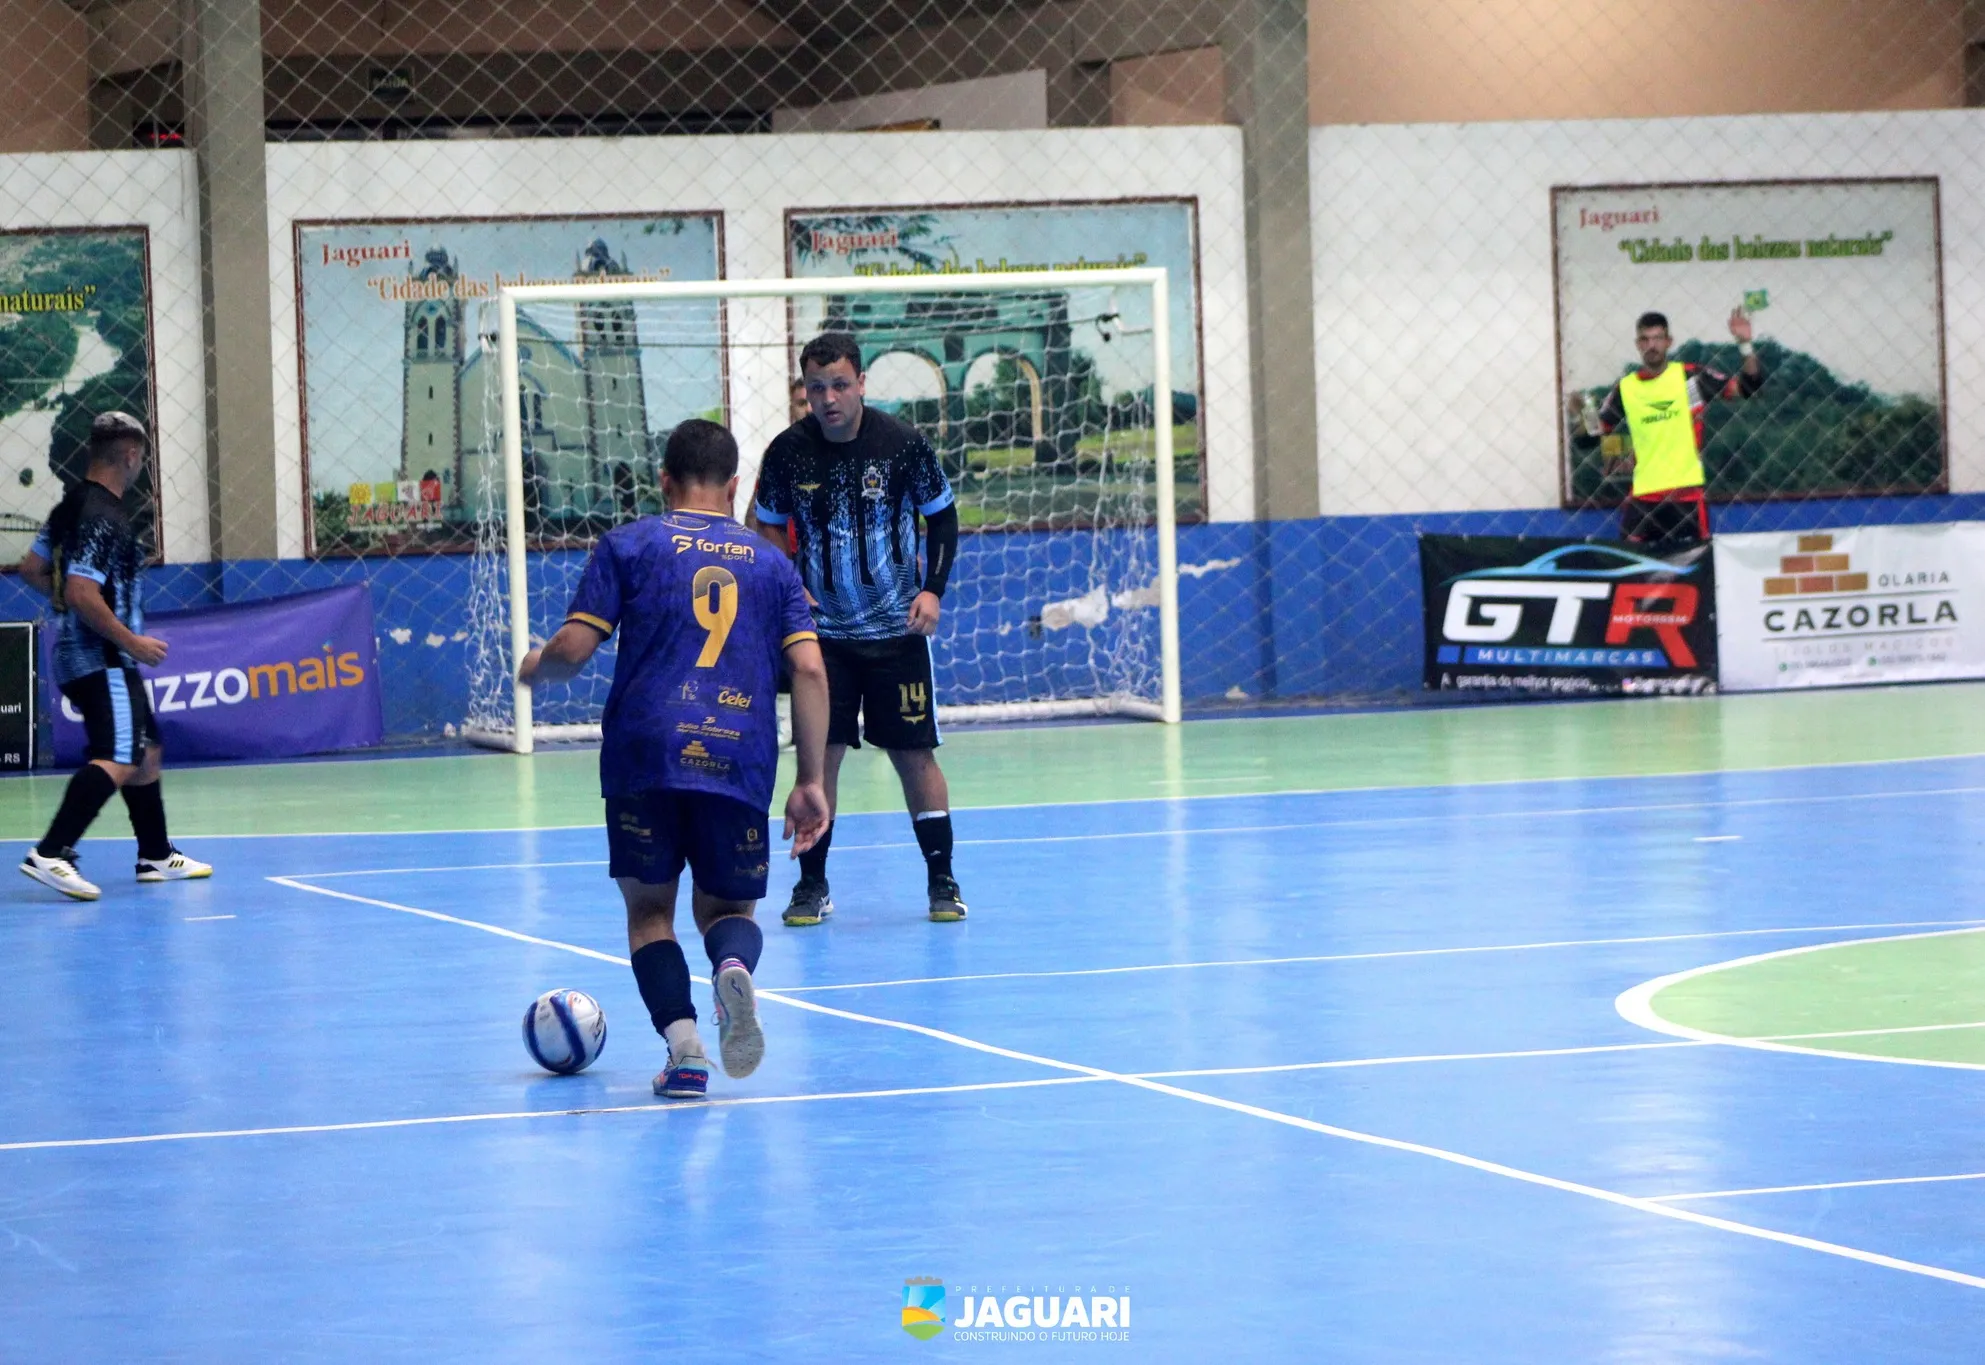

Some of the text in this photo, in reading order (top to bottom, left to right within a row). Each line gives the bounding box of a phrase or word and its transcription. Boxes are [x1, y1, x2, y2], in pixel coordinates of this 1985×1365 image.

[1579, 205, 1660, 233] Jaguari
[321, 240, 411, 267] Jaguari
[810, 226, 898, 255] Jaguari
[453, 272, 489, 298] das
[346, 499, 444, 526] JAGUARI
[696, 538, 755, 559] forfan
[721, 554, 755, 564] sports
[1878, 571, 1950, 588] OLARIA
[692, 565, 738, 668] 9
[1442, 579, 1698, 668] GTR
[1763, 600, 1958, 632] CAZORLA
[1477, 648, 1656, 665] MULTIMARCAS
[717, 690, 753, 709] Celei
[898, 682, 927, 712] 14
[4, 752, 21, 764] RS
